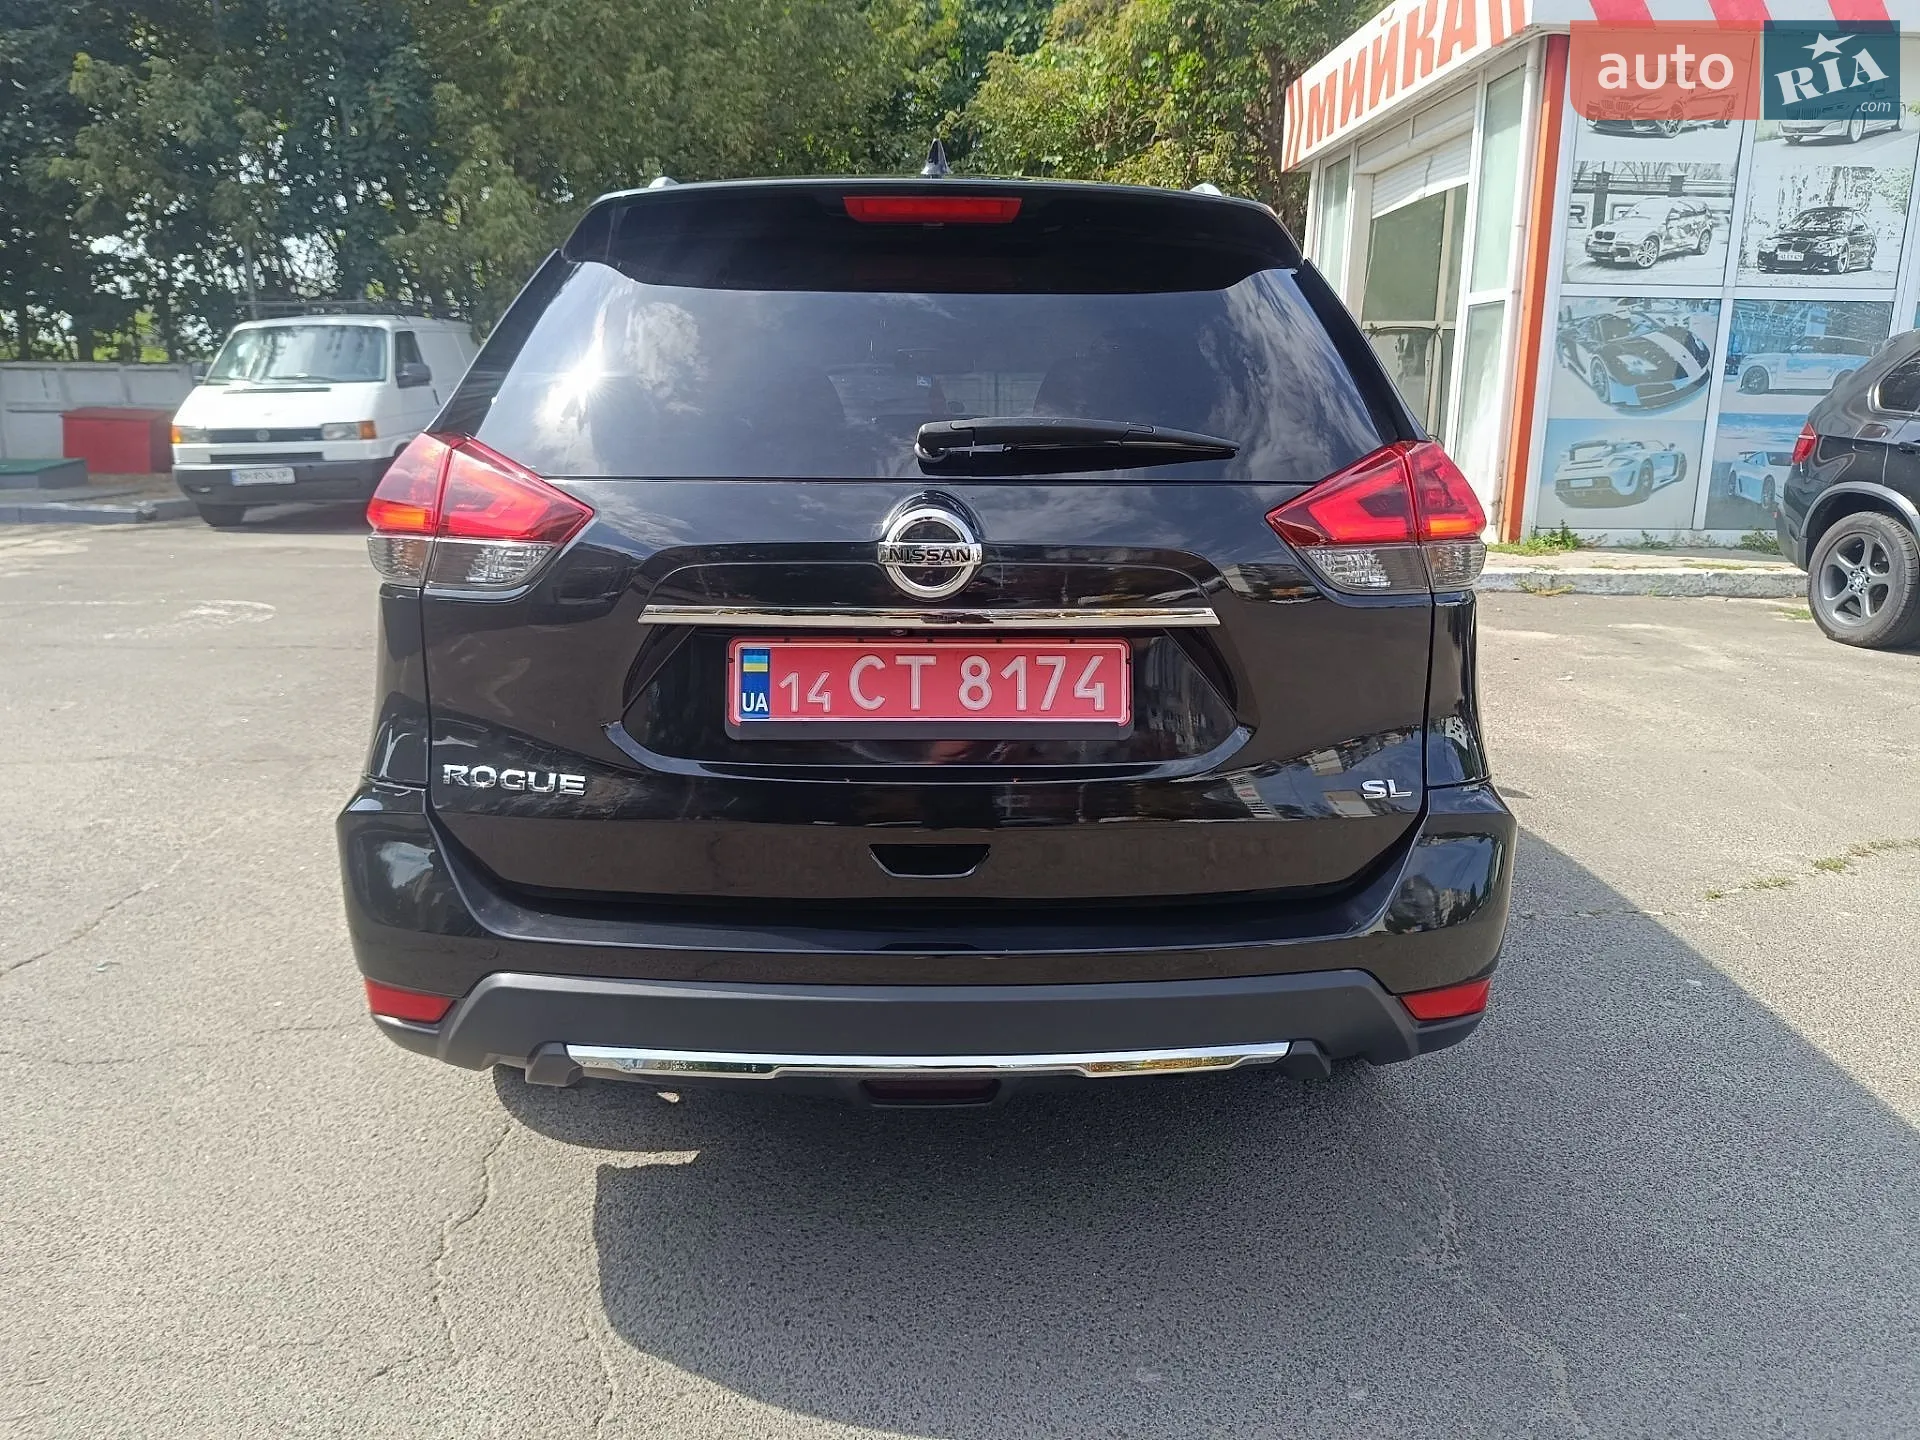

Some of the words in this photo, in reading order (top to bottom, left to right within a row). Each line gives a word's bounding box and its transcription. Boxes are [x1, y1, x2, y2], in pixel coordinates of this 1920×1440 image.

[1306, 0, 1477, 150] МИЙКА
[889, 547, 971, 562] NISSAN
[778, 671, 832, 712] 14
[848, 654, 937, 712] CT
[958, 654, 1105, 712] 8174
[742, 692, 769, 712] UA
[442, 763, 587, 797] ROGUE
[1361, 779, 1413, 799] SL
